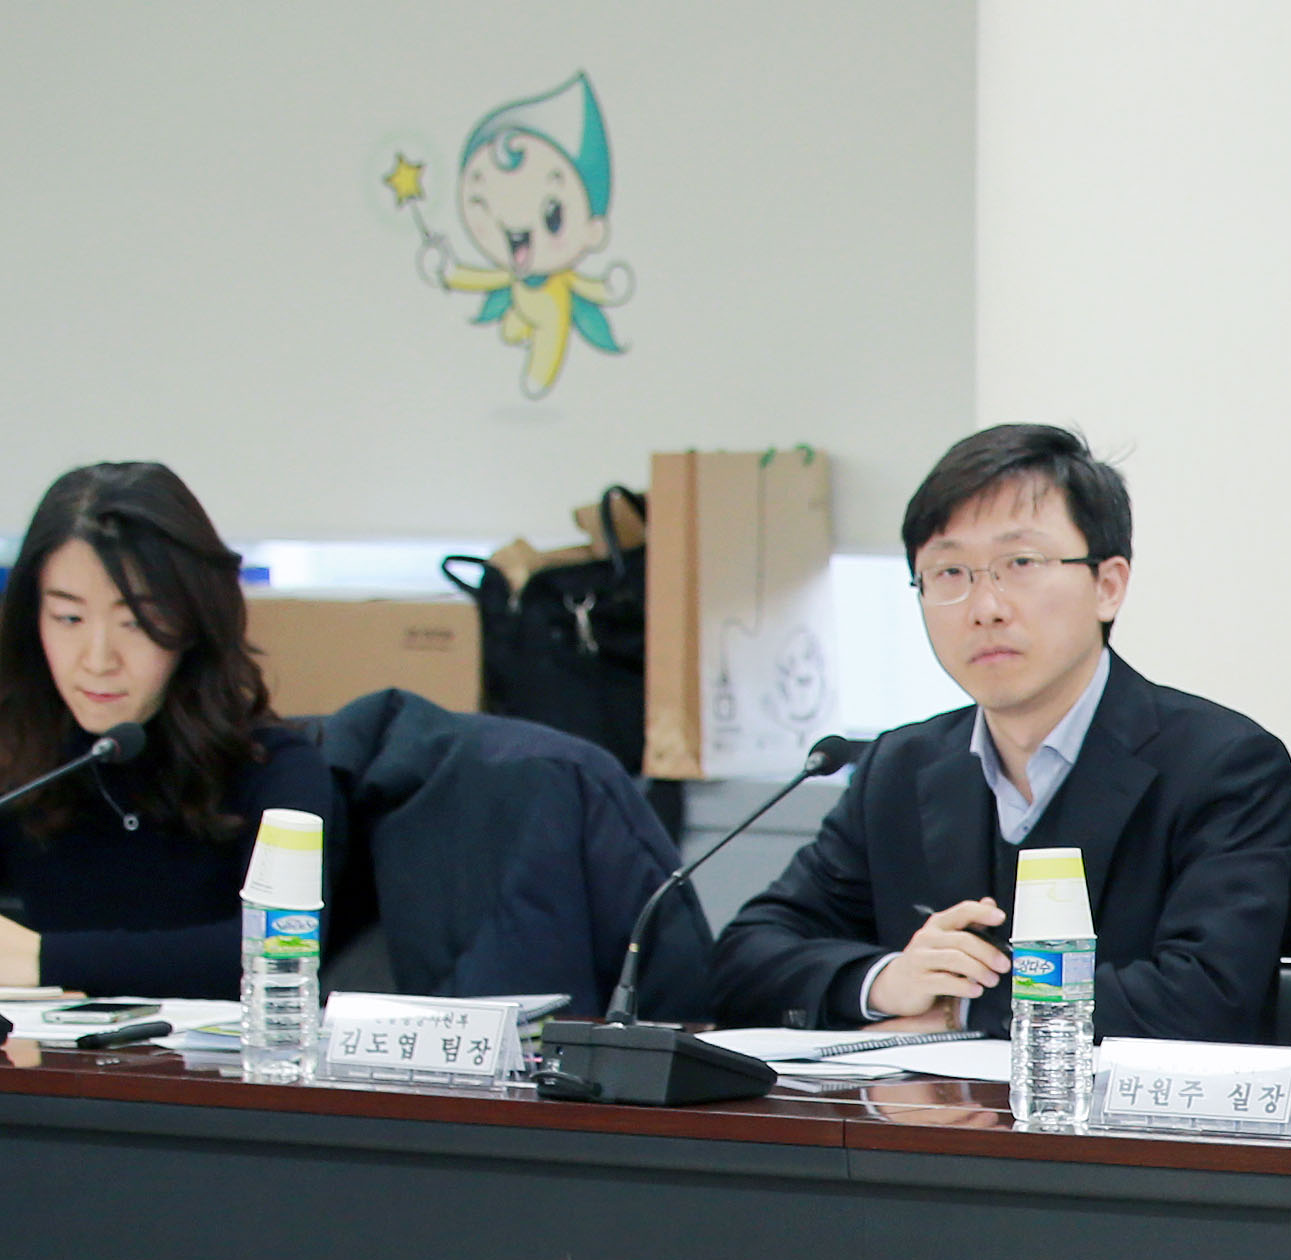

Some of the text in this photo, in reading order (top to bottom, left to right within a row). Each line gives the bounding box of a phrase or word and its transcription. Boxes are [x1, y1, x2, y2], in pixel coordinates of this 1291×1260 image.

[338, 1028, 493, 1066] 김도엽 팀장
[1118, 1075, 1287, 1115] 박원주 실장
